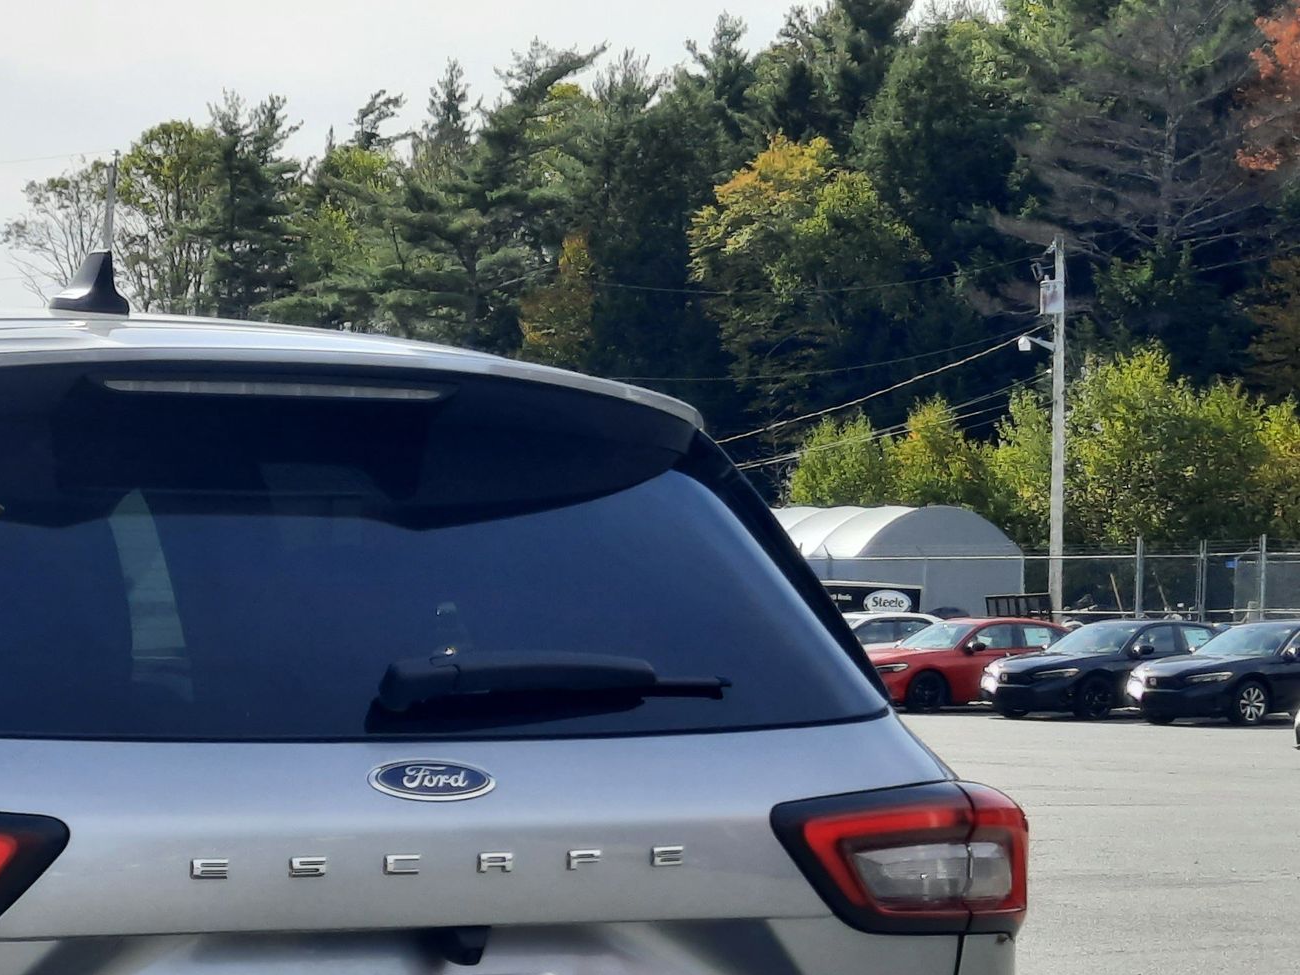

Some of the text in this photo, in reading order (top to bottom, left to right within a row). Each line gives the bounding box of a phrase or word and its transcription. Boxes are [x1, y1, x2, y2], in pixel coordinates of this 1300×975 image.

[871, 596, 905, 608] Steele
[403, 765, 468, 789] Ford
[190, 846, 684, 879] ESCAPE
